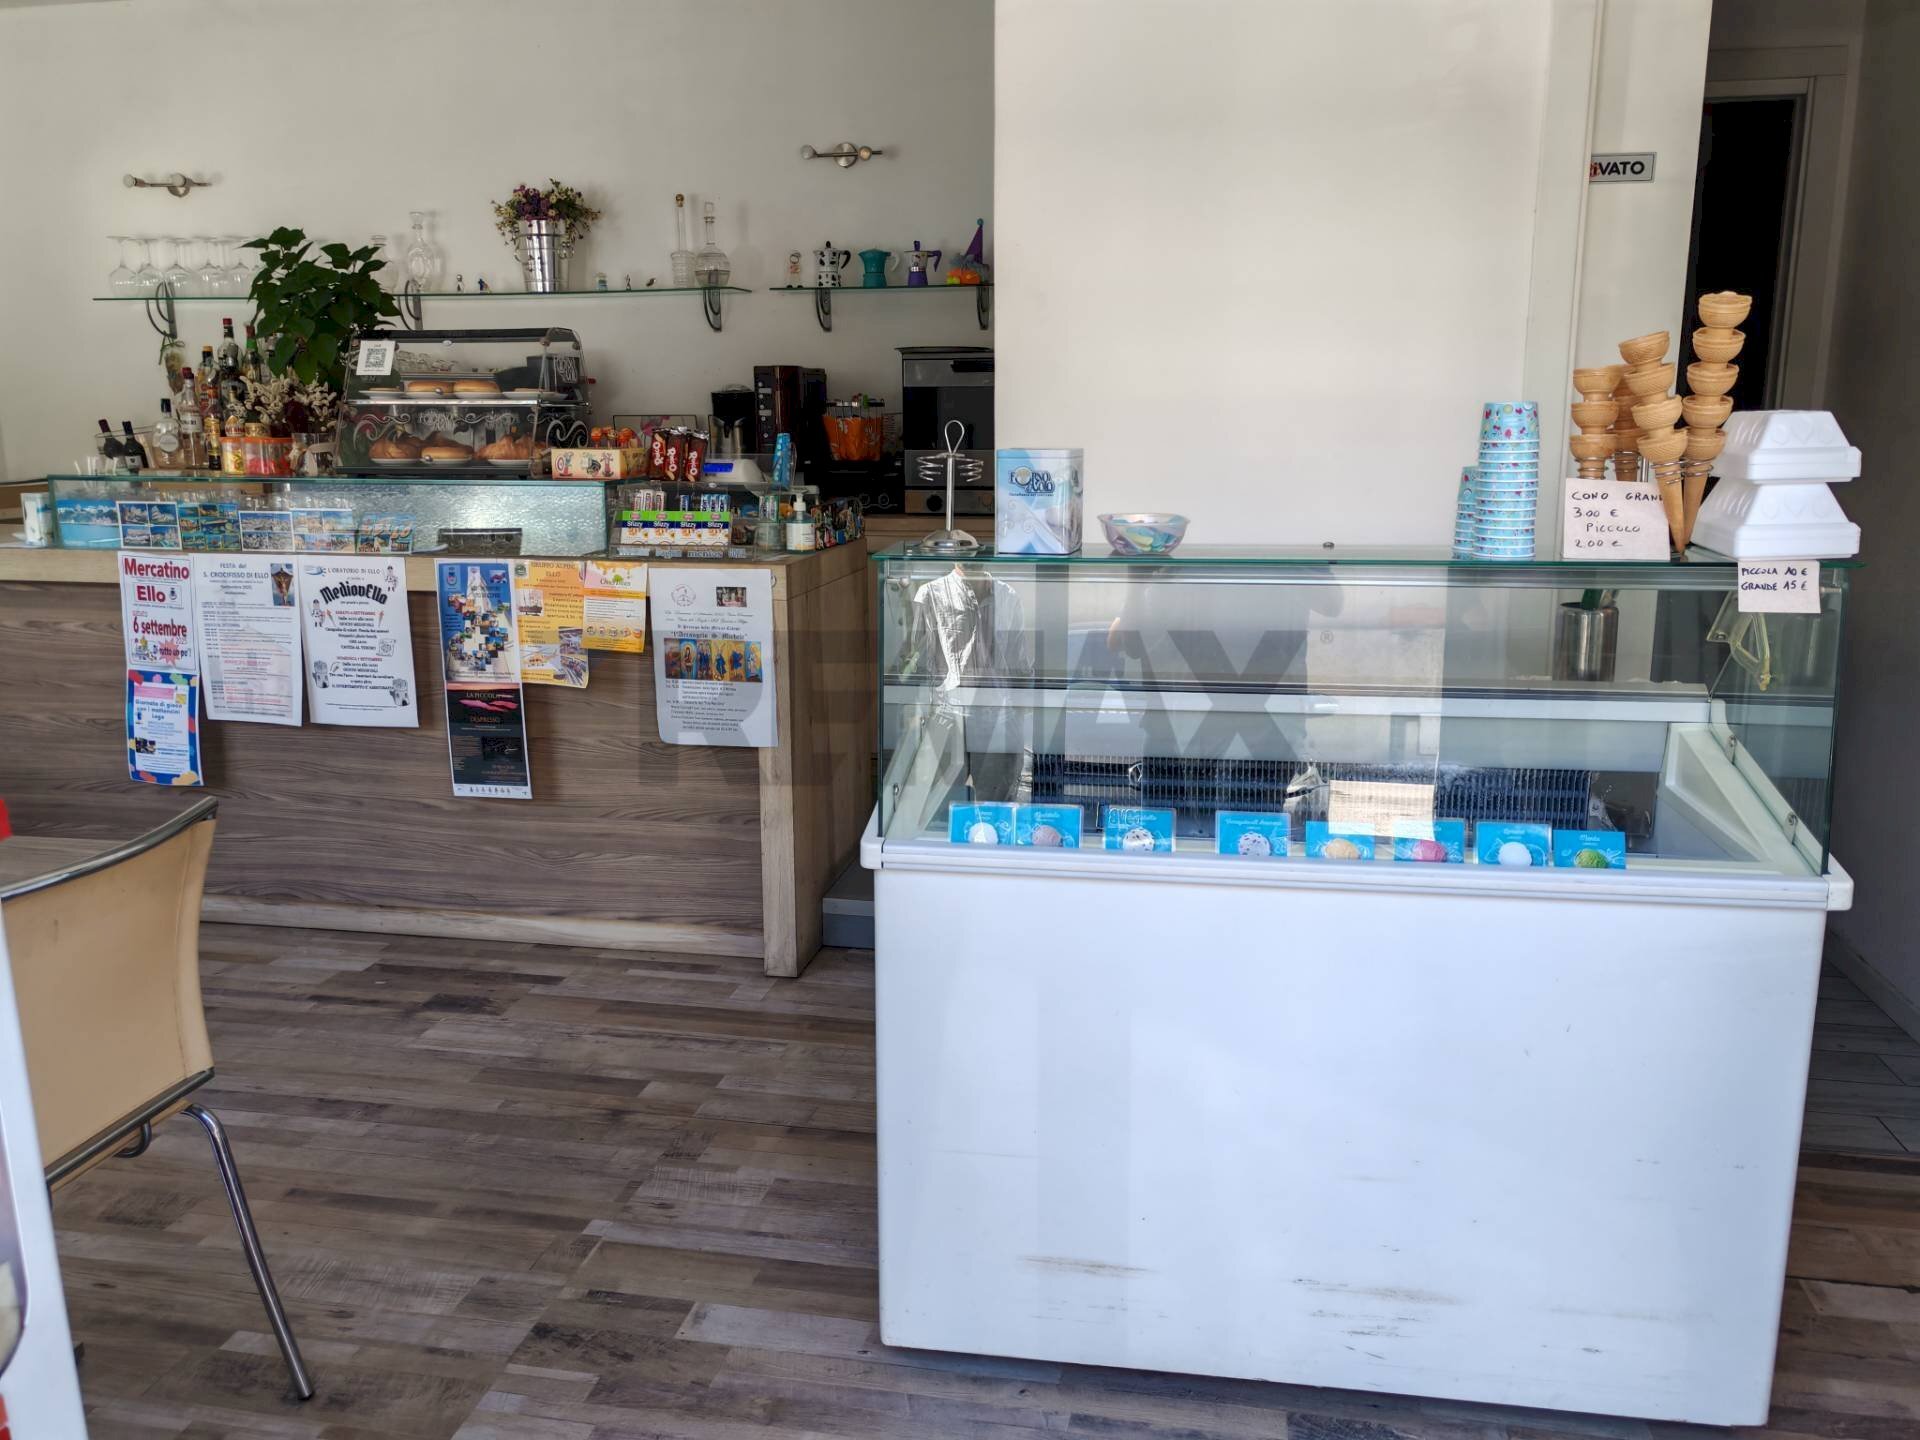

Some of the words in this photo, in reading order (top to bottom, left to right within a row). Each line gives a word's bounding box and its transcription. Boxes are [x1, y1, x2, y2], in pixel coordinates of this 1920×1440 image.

[1571, 491, 1609, 501] CONO
[1610, 508, 1619, 518] €
[123, 557, 190, 579] Mercatino
[1741, 567, 1778, 576] PICCOLA
[1784, 566, 1798, 576] 10
[1800, 567, 1809, 576] €
[1740, 581, 1778, 591] GRANDE
[1783, 580, 1797, 591] 15
[136, 585, 167, 603] Ello
[133, 616, 139, 634] 6
[140, 618, 188, 638] settembre
